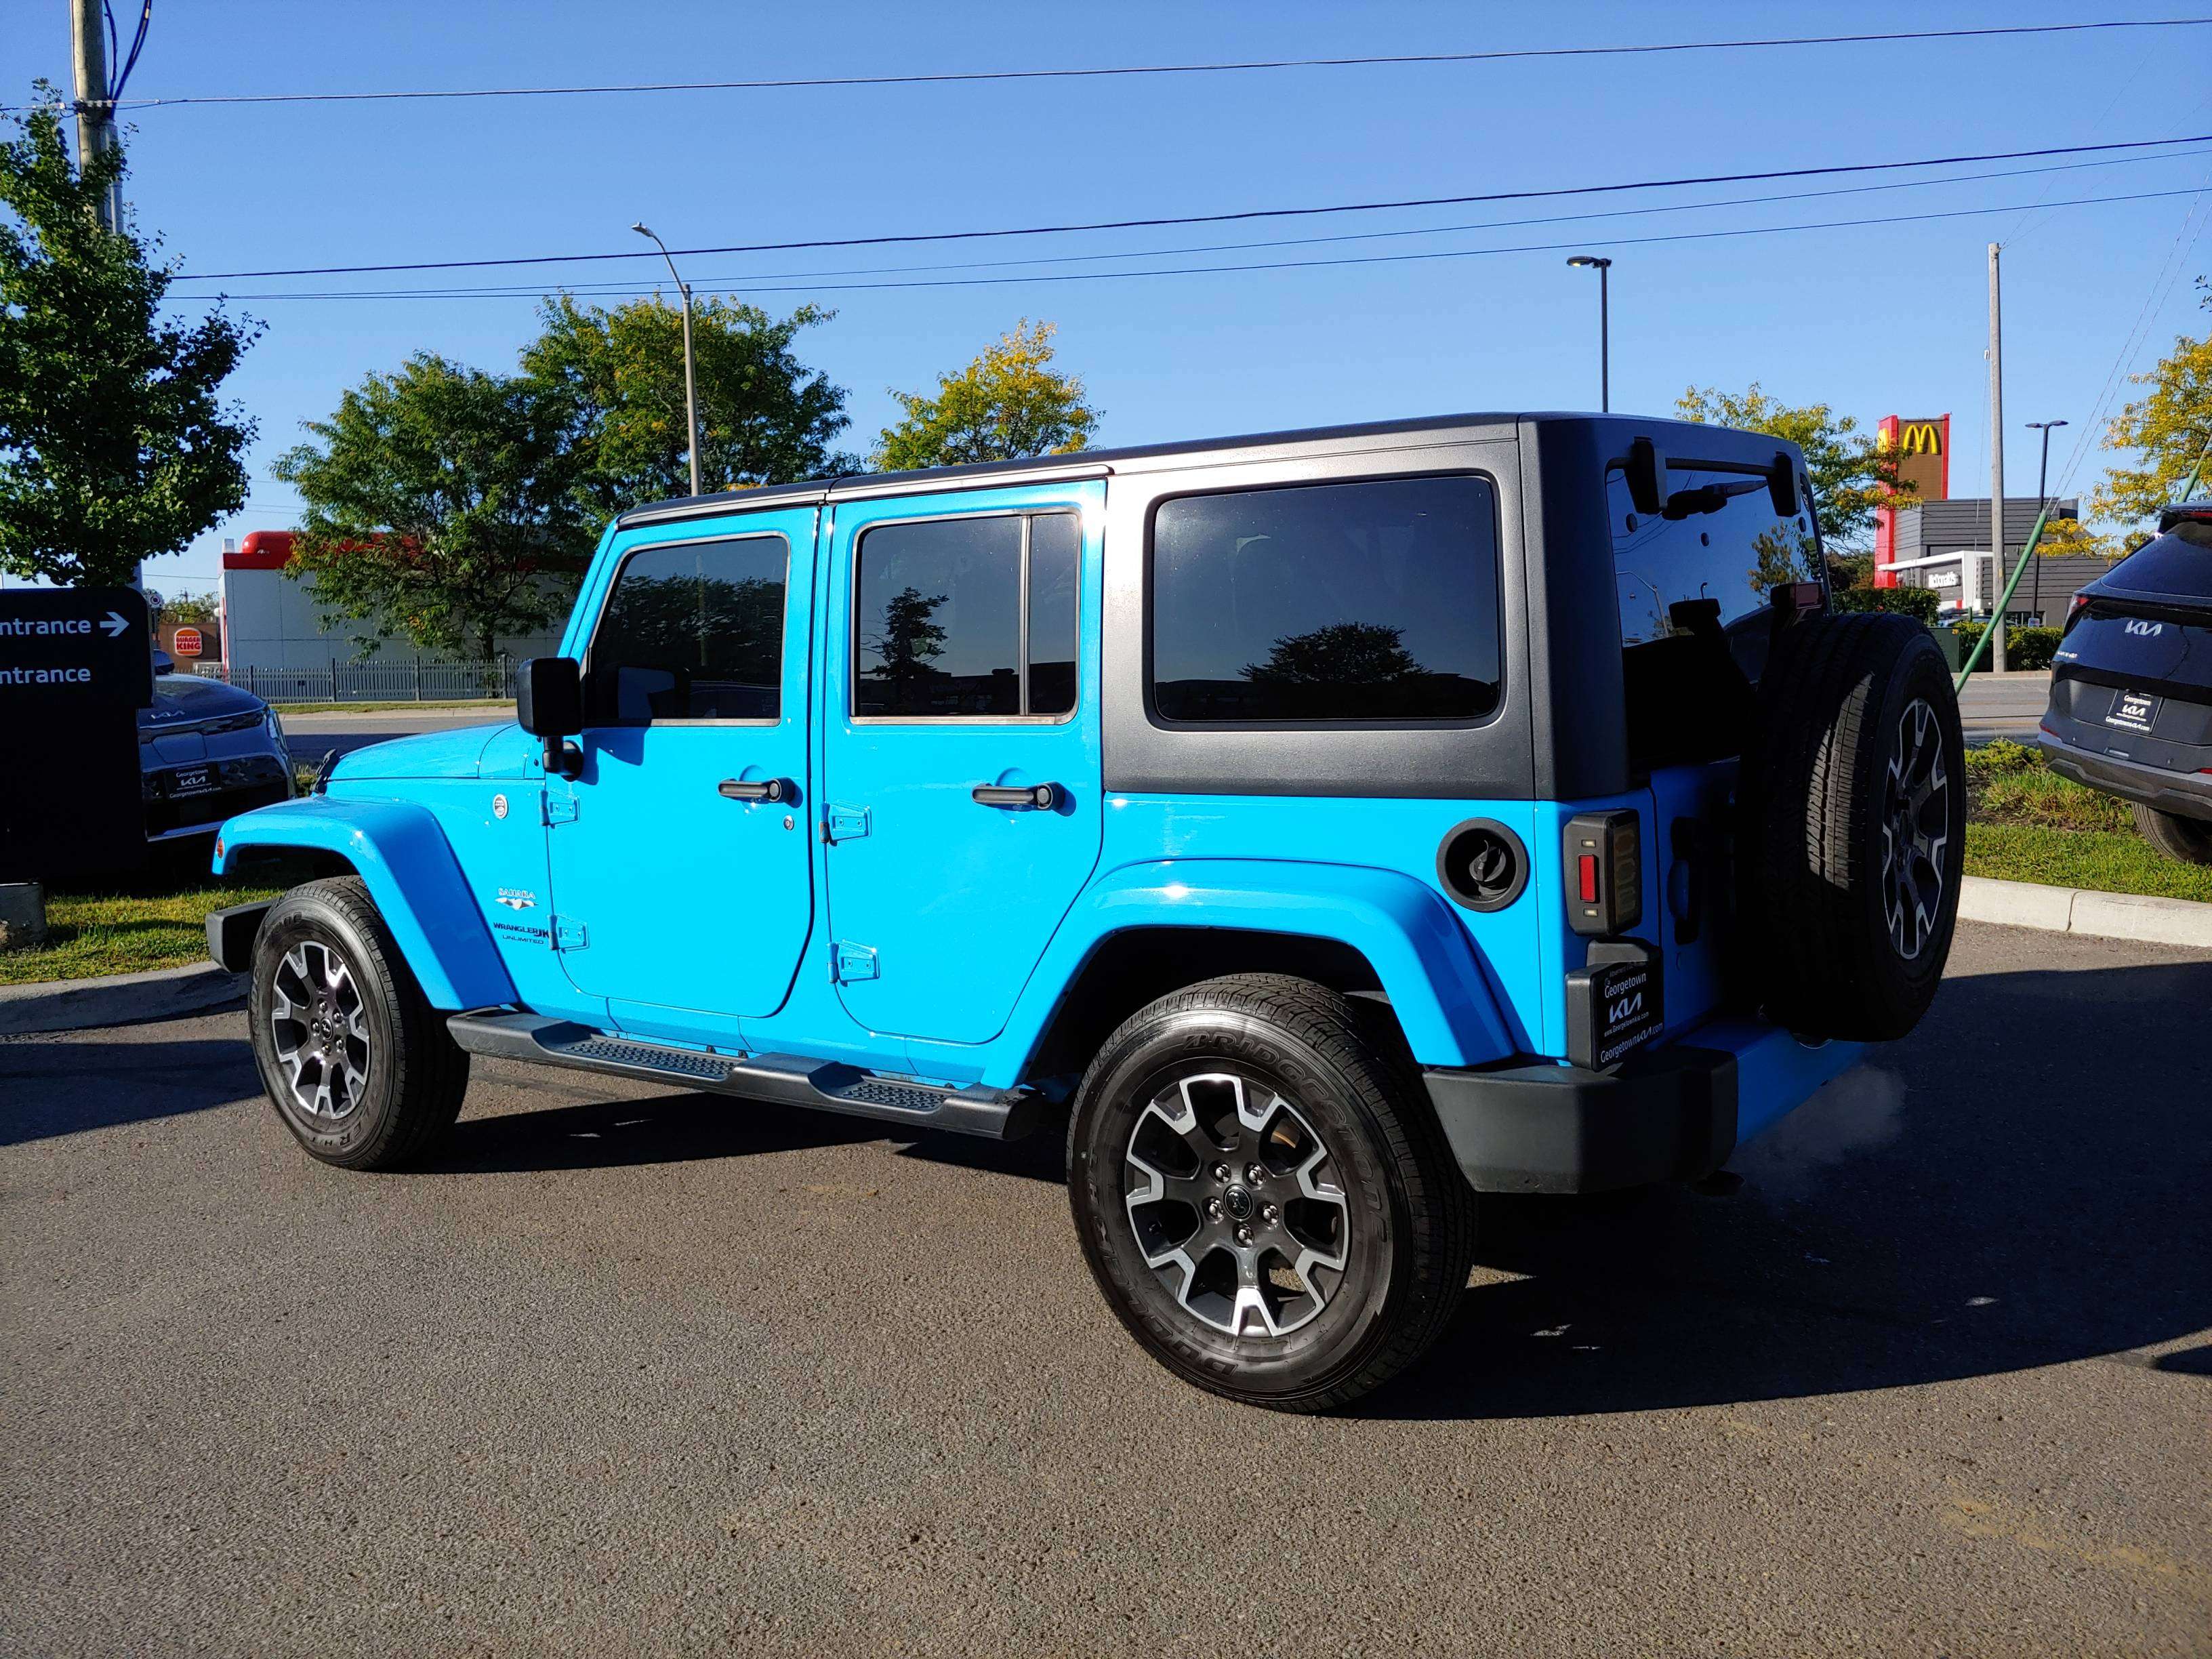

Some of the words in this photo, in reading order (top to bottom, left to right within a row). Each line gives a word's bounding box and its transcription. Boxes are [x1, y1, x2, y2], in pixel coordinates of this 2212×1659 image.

[1928, 571, 1957, 588] McDonald's
[2124, 619, 2163, 638] KIA
[2123, 695, 2152, 706] Georgetown
[176, 769, 209, 779] Georgetown
[498, 887, 536, 900] SAHARA
[502, 935, 544, 945] UNLIMITED
[1604, 972, 1647, 999] Georgetown
[1609, 992, 1642, 1024] KIA
[1182, 1031, 1389, 1244] BRIDGESTONE
